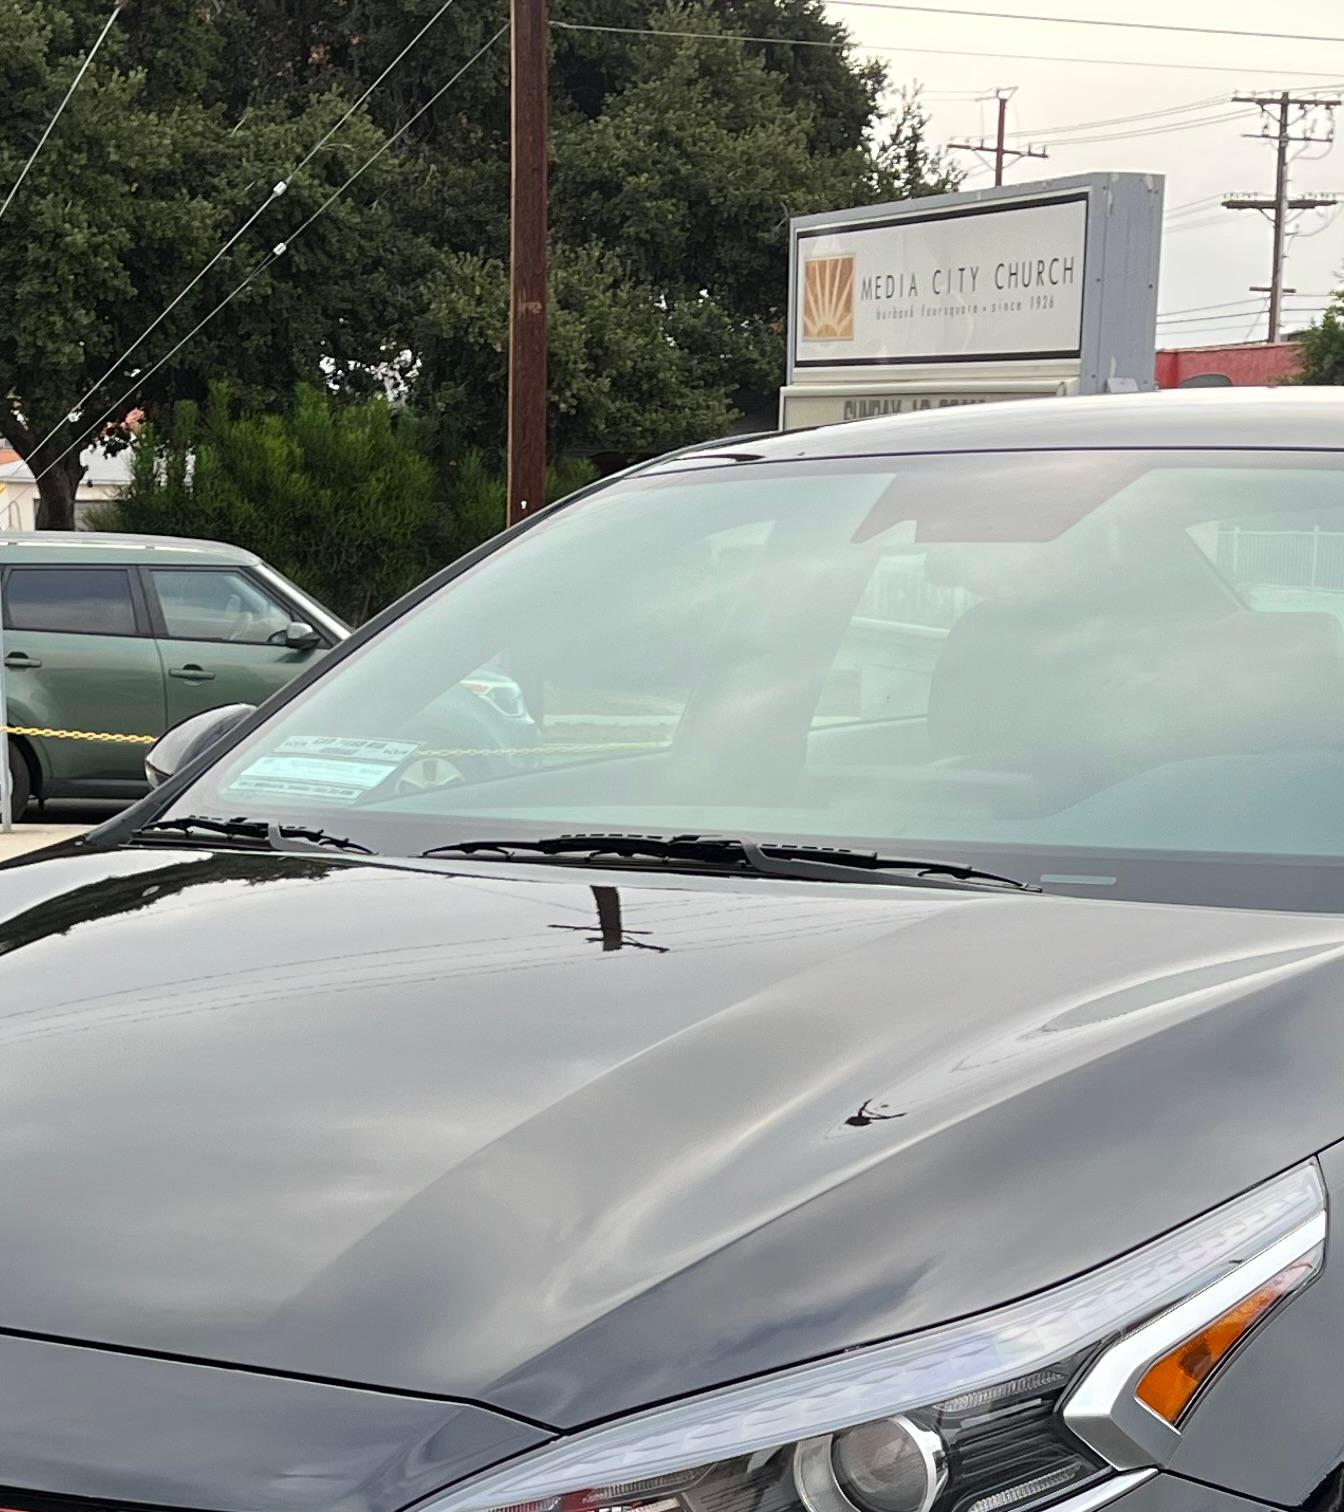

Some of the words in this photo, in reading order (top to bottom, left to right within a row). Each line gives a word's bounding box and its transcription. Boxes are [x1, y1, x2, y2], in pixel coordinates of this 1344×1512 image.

[861, 272, 918, 301] MEDIA
[932, 266, 980, 295] CITY
[994, 256, 1075, 290] CHURCH
[921, 302, 978, 319] foursquare
[991, 299, 1022, 312] since
[1029, 294, 1055, 311] 1926
